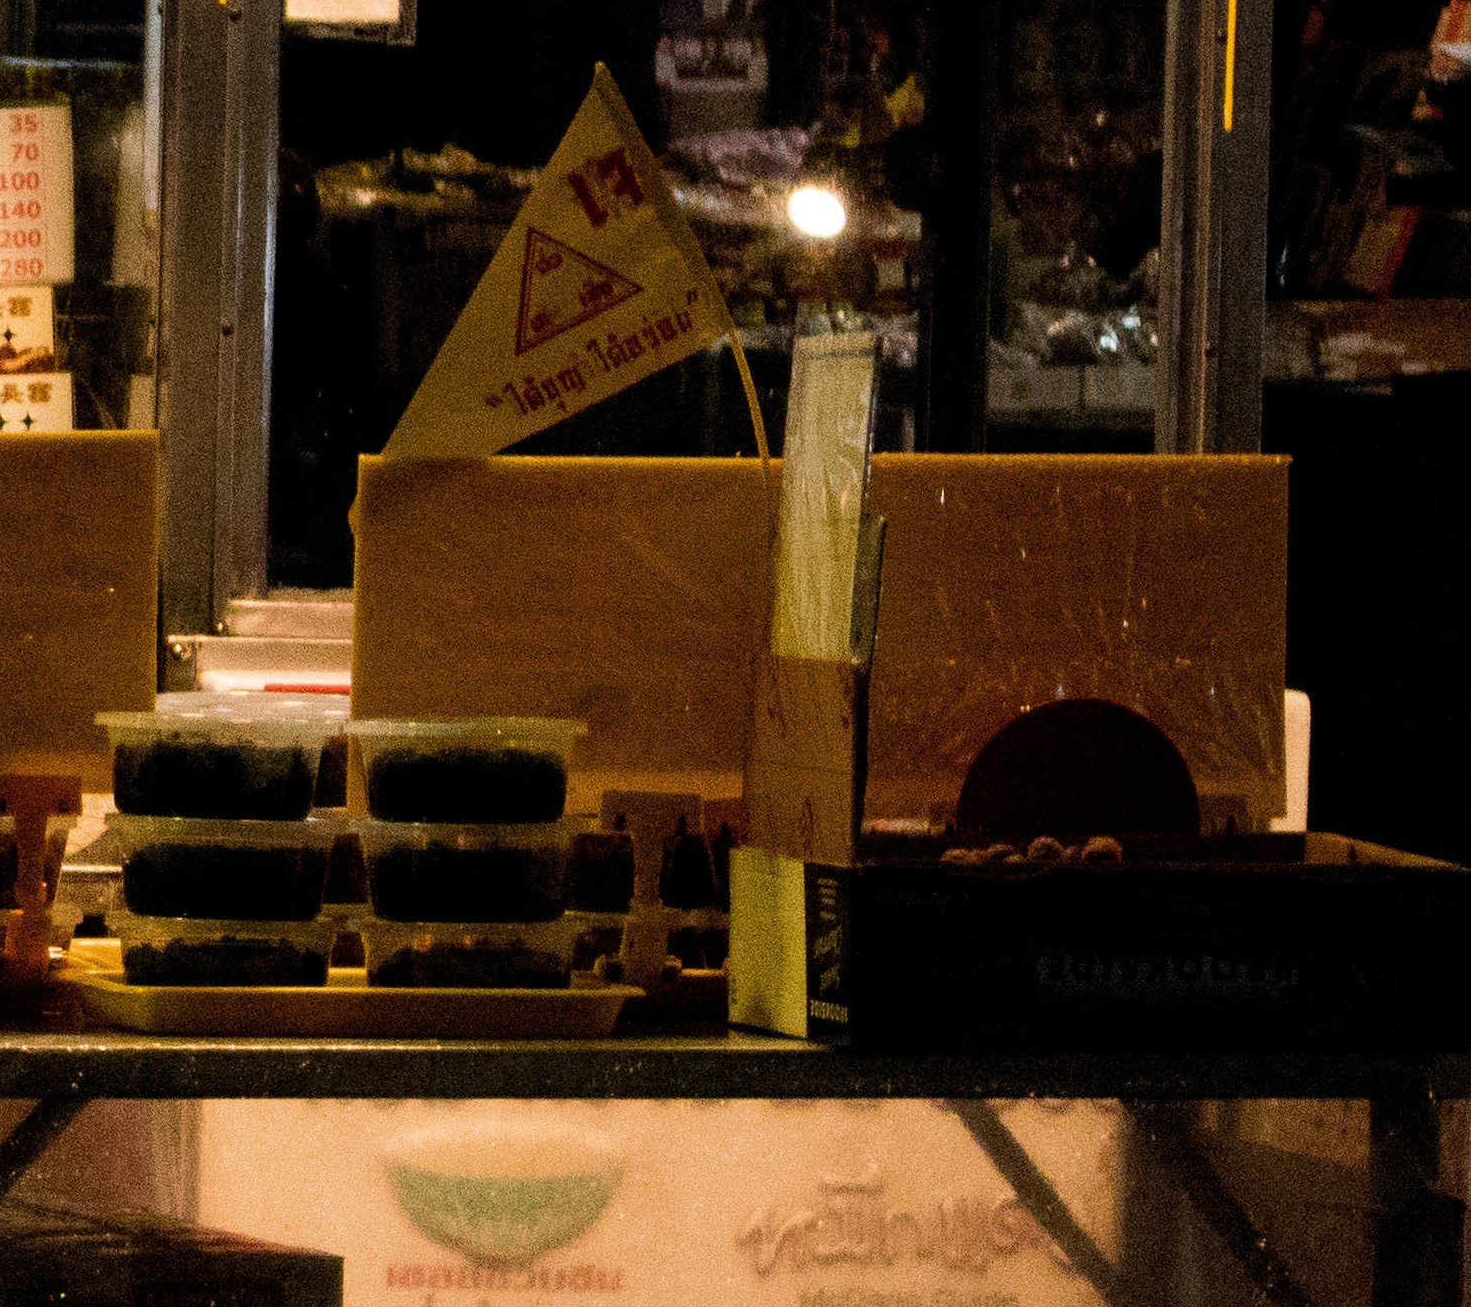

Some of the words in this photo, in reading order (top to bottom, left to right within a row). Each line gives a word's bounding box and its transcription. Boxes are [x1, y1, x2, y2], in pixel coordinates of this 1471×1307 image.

[10, 114, 38, 134] 35
[11, 143, 39, 162] 70
[0, 230, 42, 249] 200
[0, 258, 43, 278] 280
